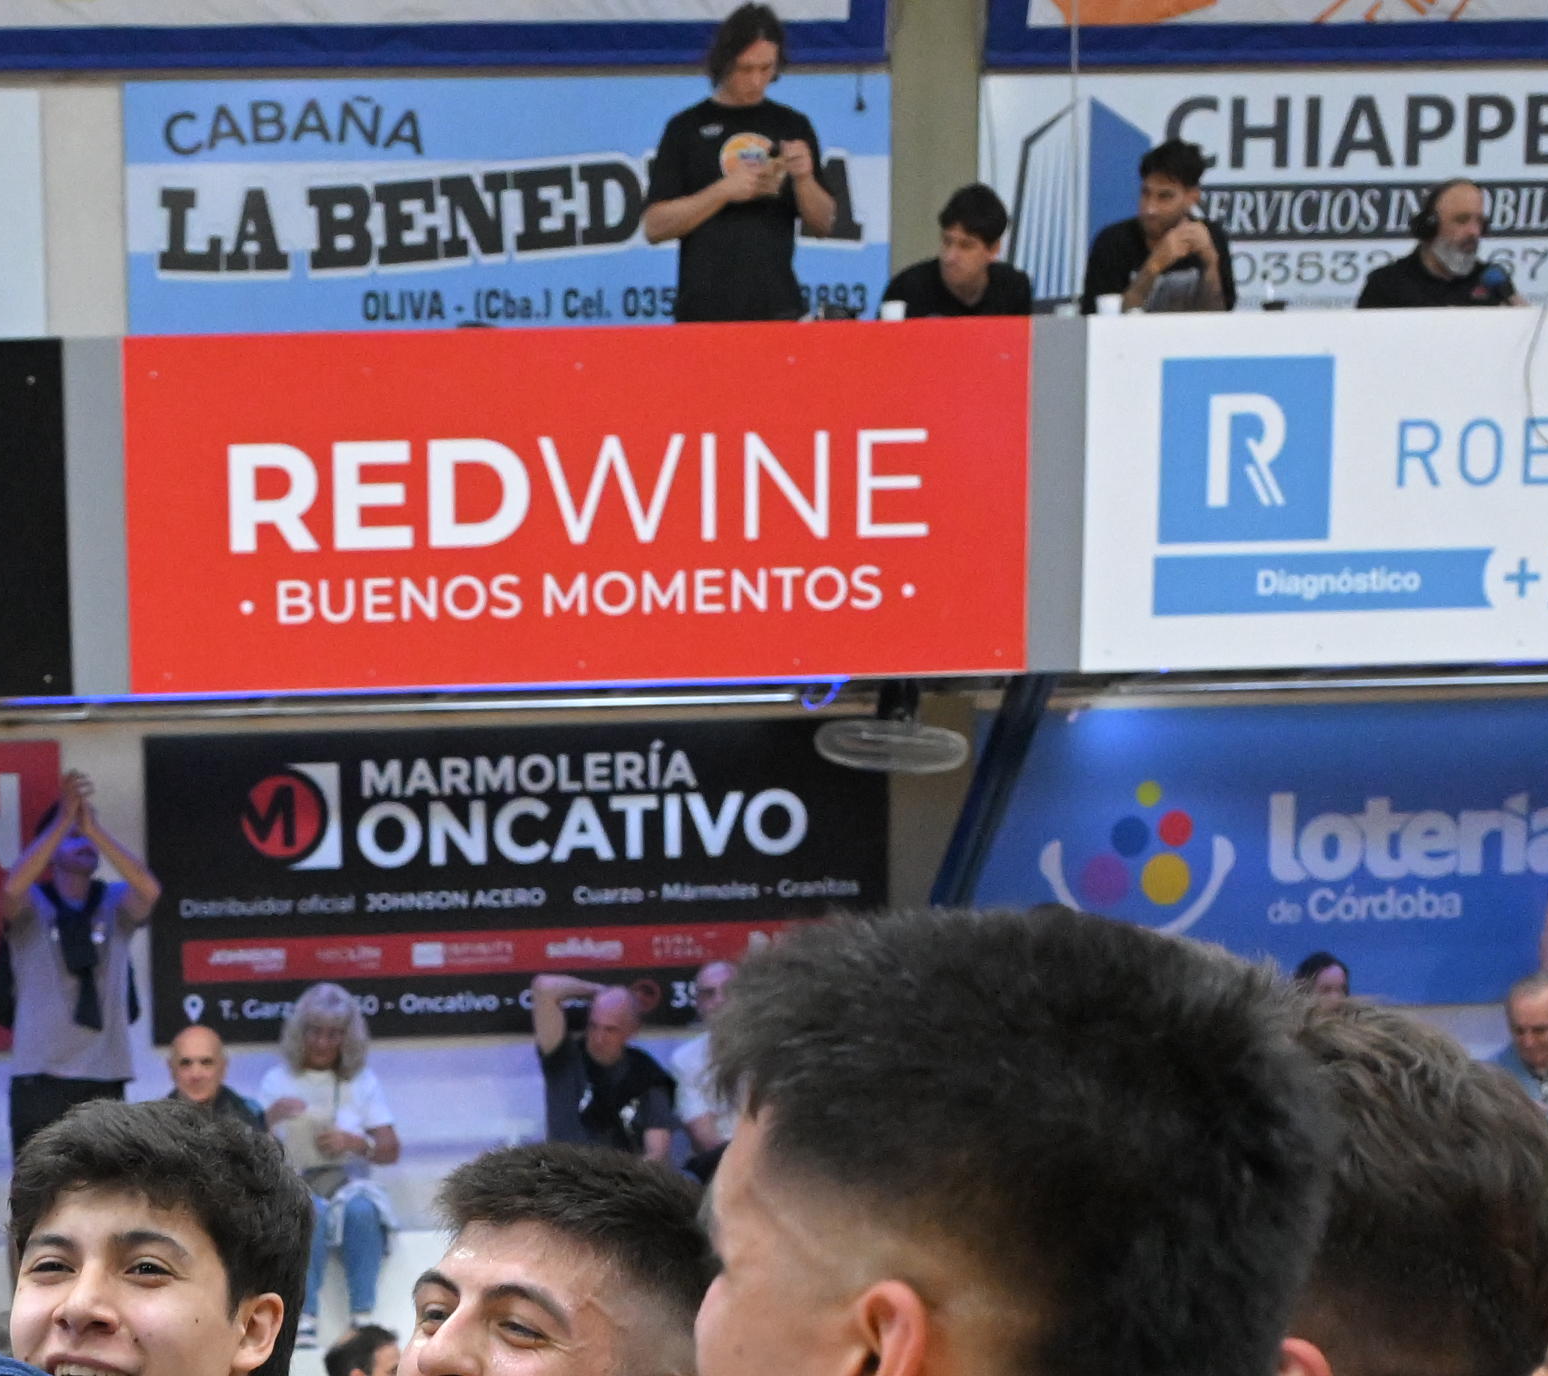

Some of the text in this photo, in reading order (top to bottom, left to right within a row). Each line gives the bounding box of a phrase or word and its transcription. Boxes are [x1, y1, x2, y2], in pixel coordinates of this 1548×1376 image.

[164, 95, 423, 155] CABAÑA
[158, 185, 290, 273] LA
[361, 290, 446, 322] OLIVA
[275, 564, 883, 625] BUENOS MOMENTOS
[1256, 563, 1422, 600] Diagnóstico
[360, 738, 699, 799] MARMOLERÍA
[355, 787, 808, 868] ONCATIVO
[364, 889, 469, 913] JOHNSON
[474, 885, 547, 909] ACERO
[1267, 885, 1463, 926] de Córdoba
